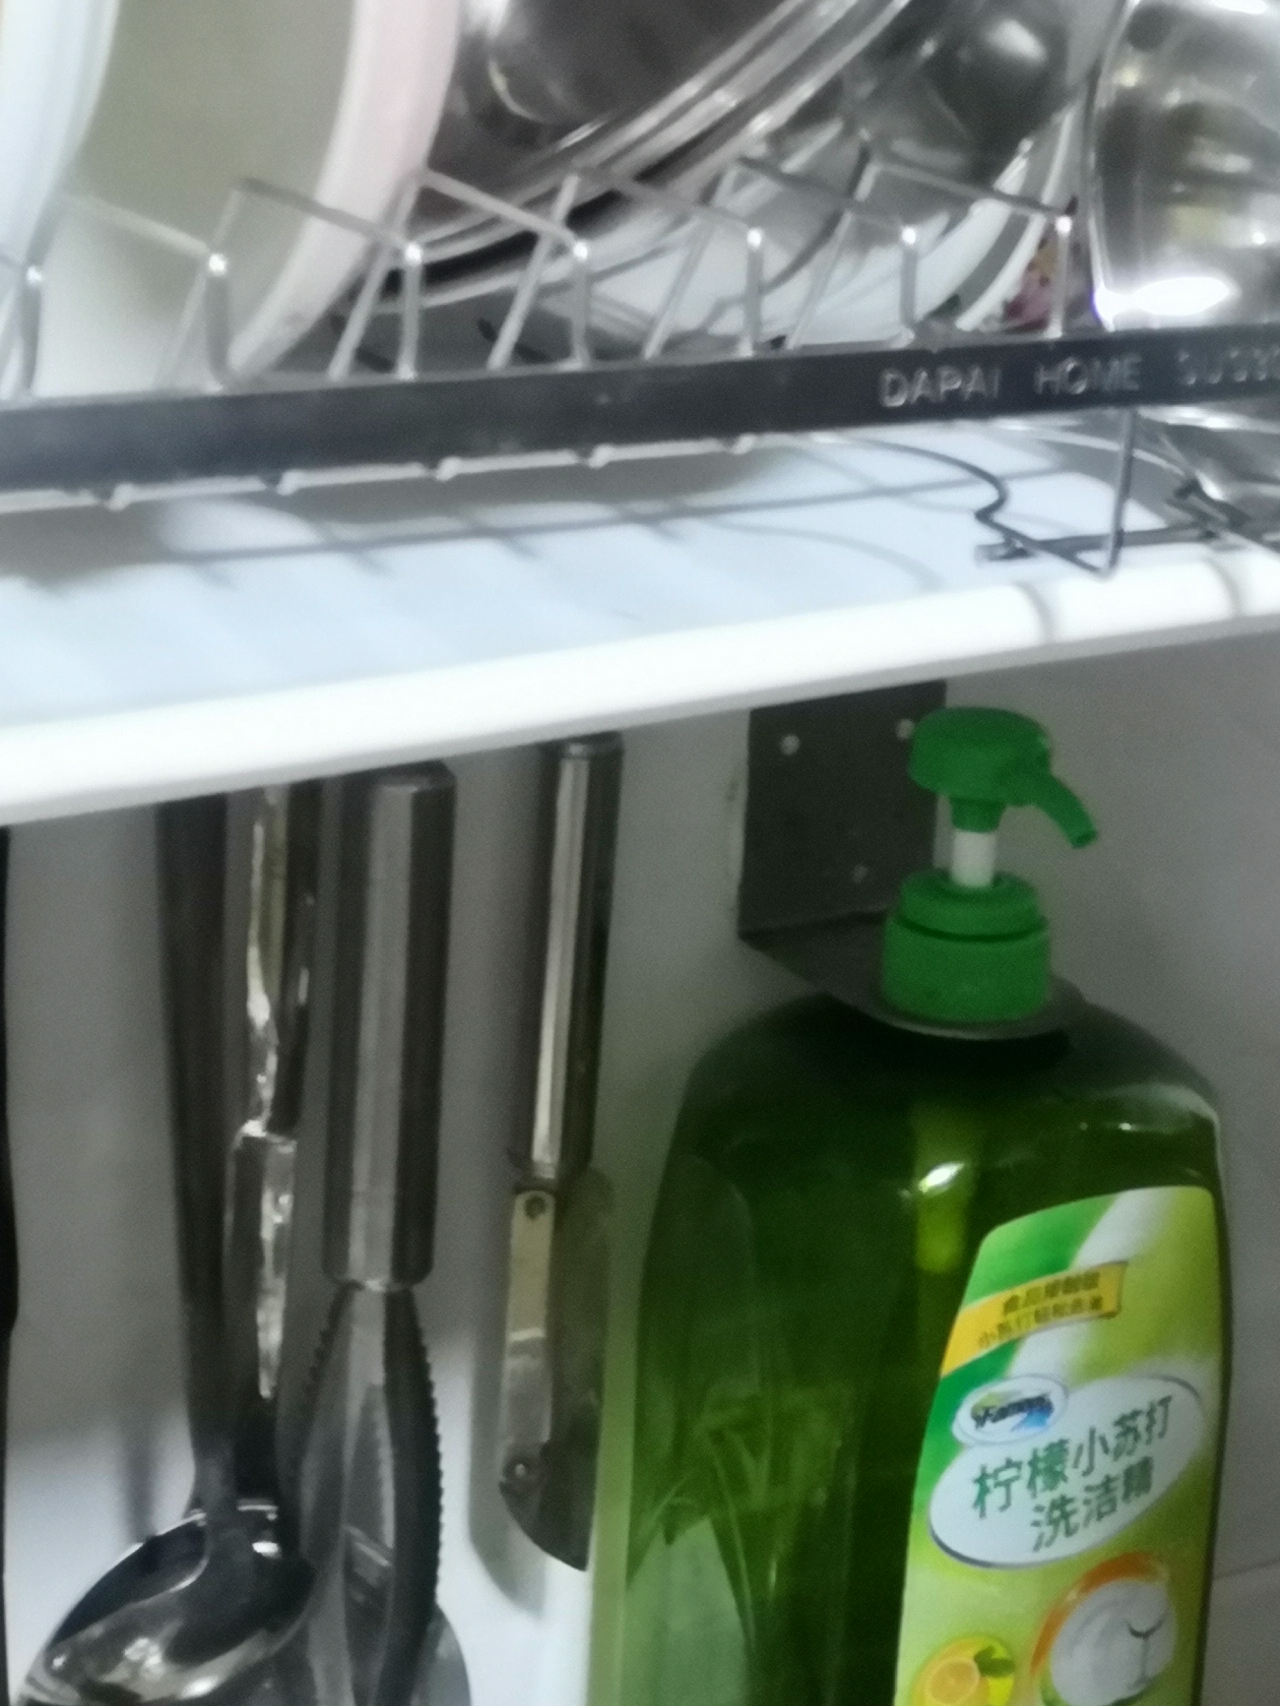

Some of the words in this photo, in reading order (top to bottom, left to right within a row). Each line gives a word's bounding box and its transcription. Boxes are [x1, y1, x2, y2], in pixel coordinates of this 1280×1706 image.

[1034, 352, 1141, 396] HOME
[973, 1394, 1173, 1519] 柠檬小苏打
[1031, 1456, 1154, 1553] 洗洁精
